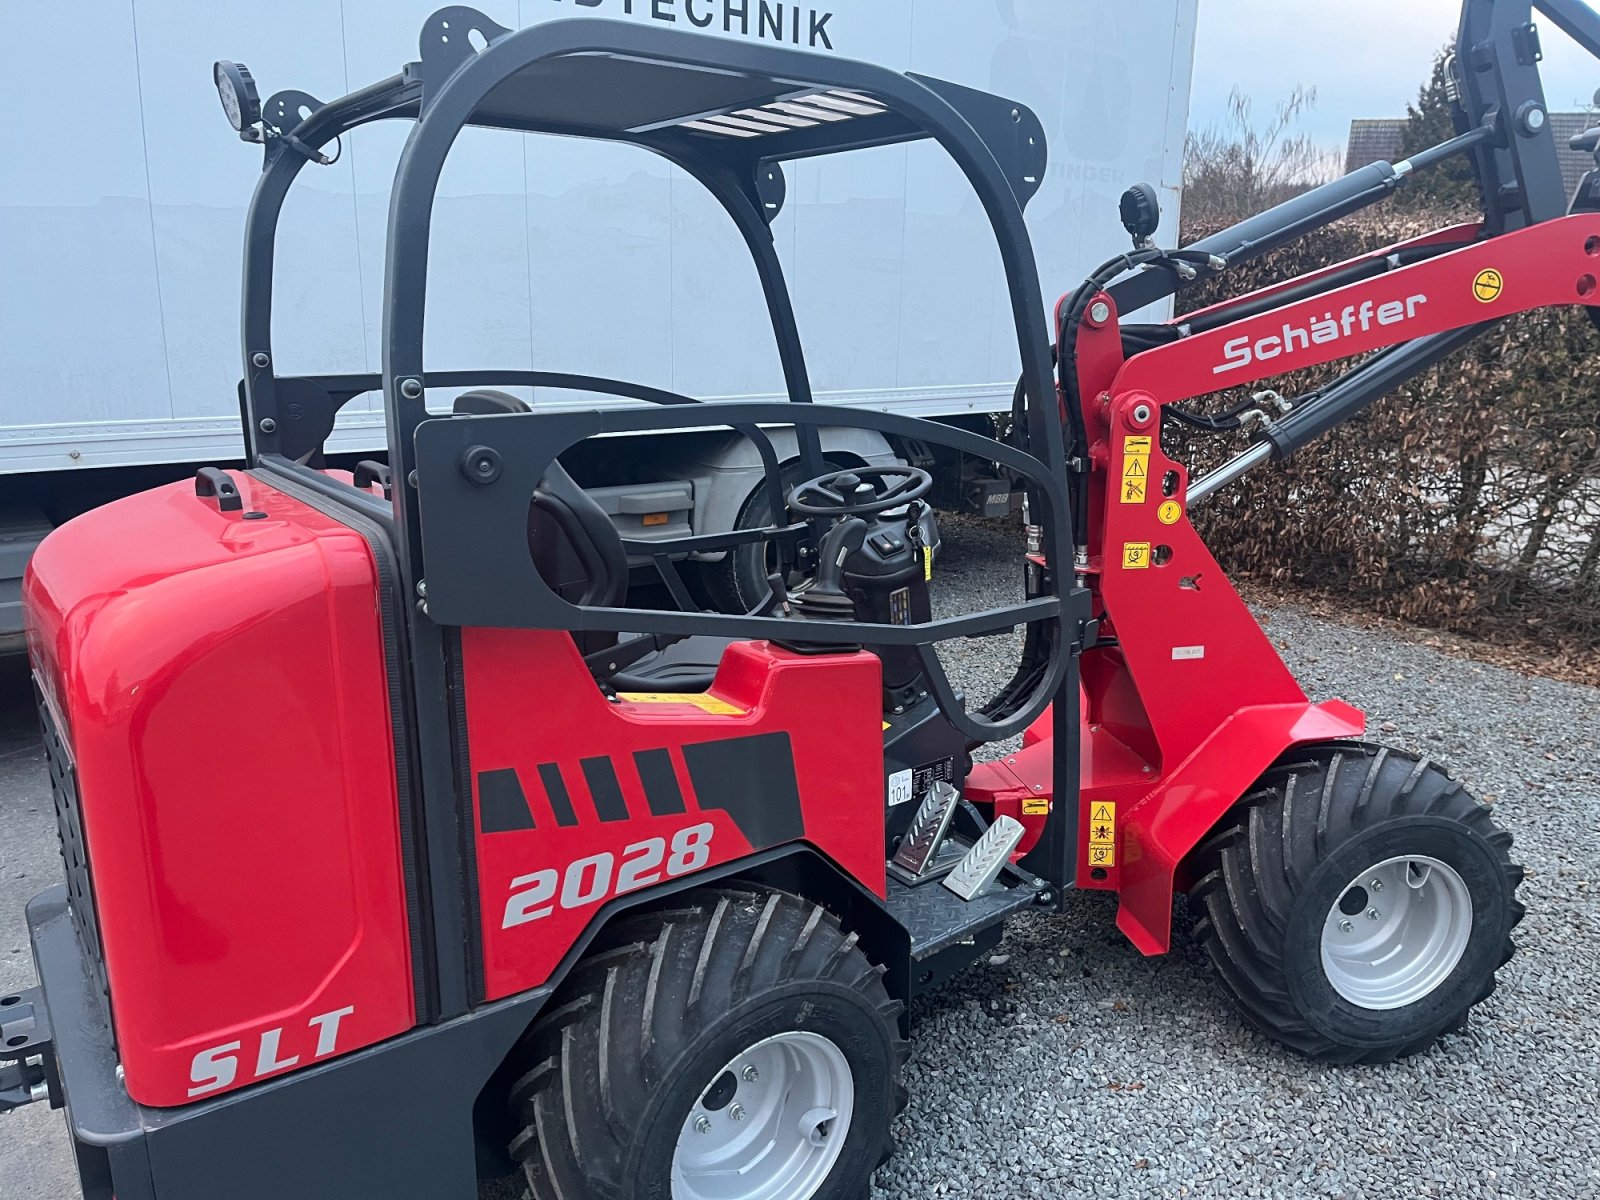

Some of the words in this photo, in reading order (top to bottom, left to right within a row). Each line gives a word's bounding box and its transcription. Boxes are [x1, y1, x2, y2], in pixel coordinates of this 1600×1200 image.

[1213, 294, 1427, 374] Schäffer
[986, 493, 1009, 504] MBB
[891, 785, 906, 804] 101
[502, 822, 714, 929] 2028
[188, 1005, 353, 1097] SLT
